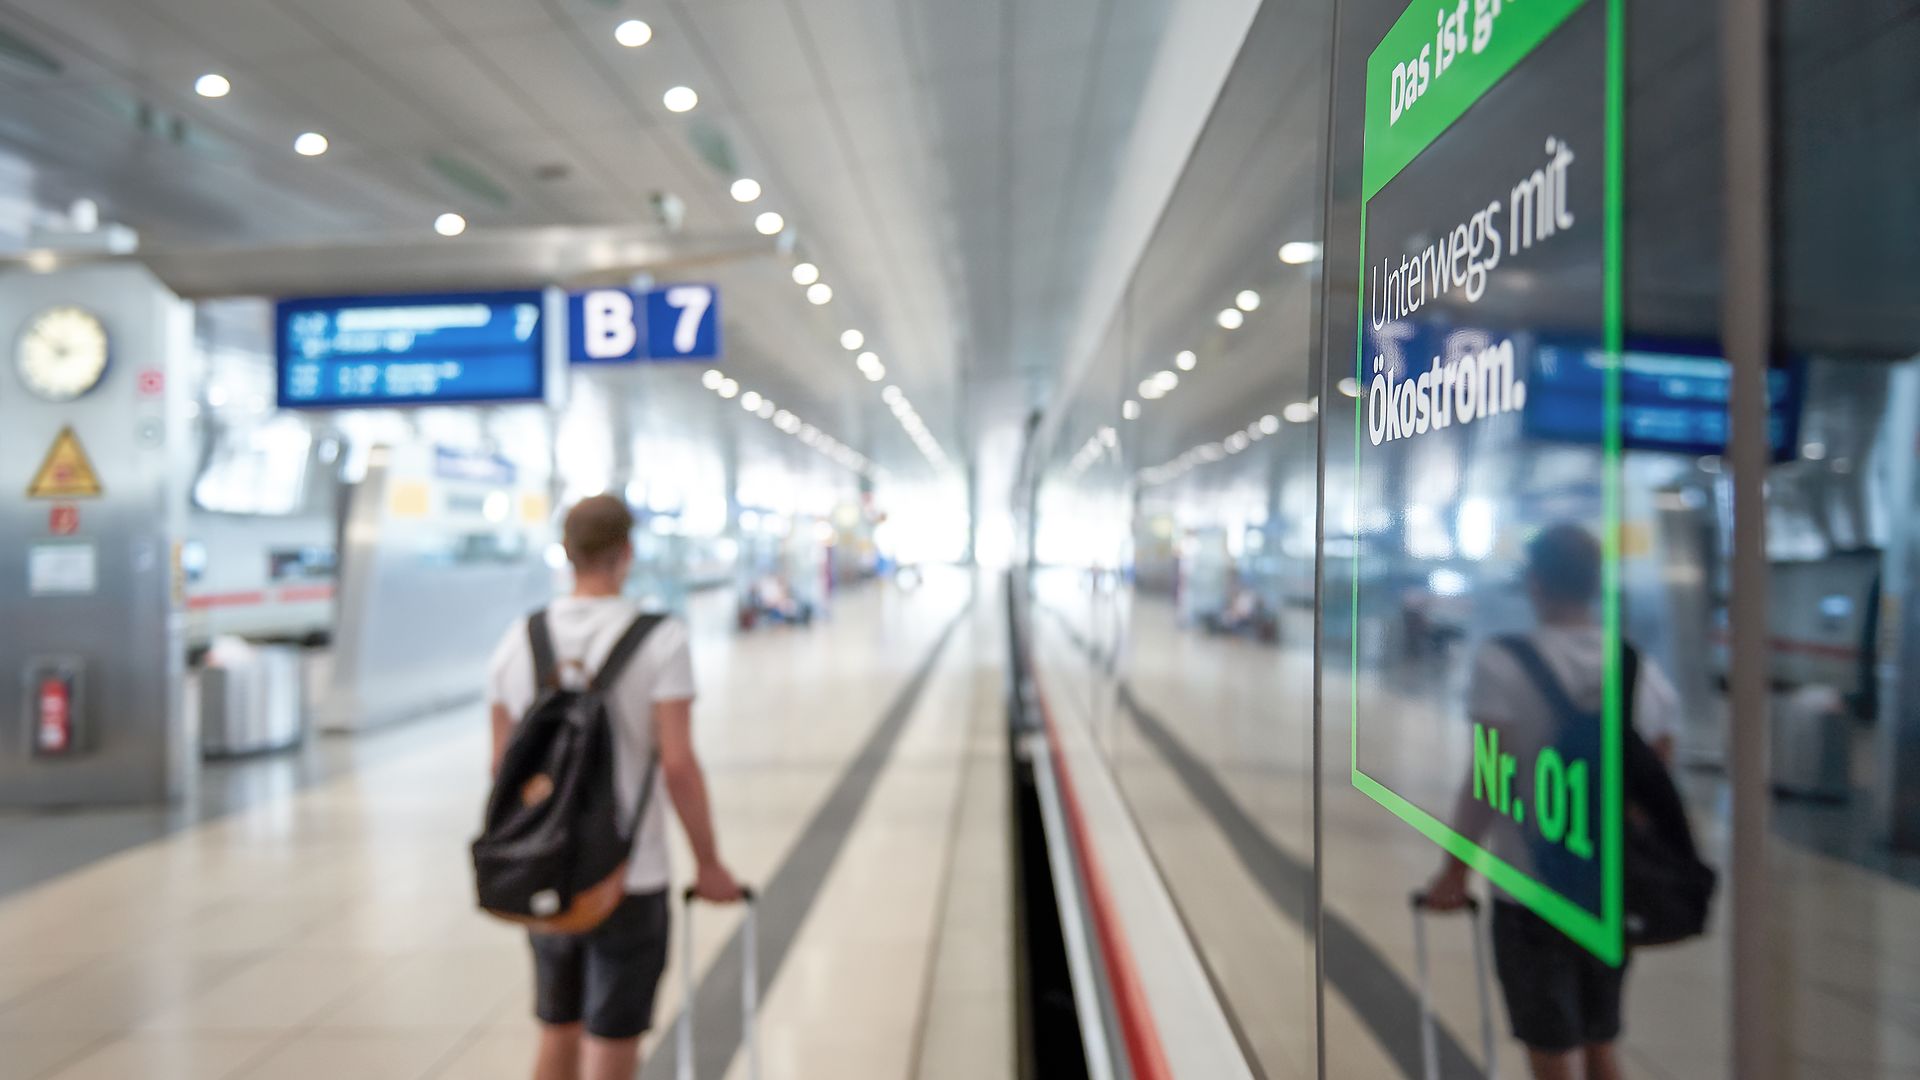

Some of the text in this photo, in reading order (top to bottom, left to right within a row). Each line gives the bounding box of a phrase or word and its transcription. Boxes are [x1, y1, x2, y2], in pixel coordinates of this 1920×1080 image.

[1389, 0, 1468, 127] Das ist
[1371, 135, 1574, 331] Unterwegs mit
[583, 287, 711, 359] B 7
[1368, 338, 1527, 446] Ökostrom.
[1473, 722, 1594, 861] Nr. 01
